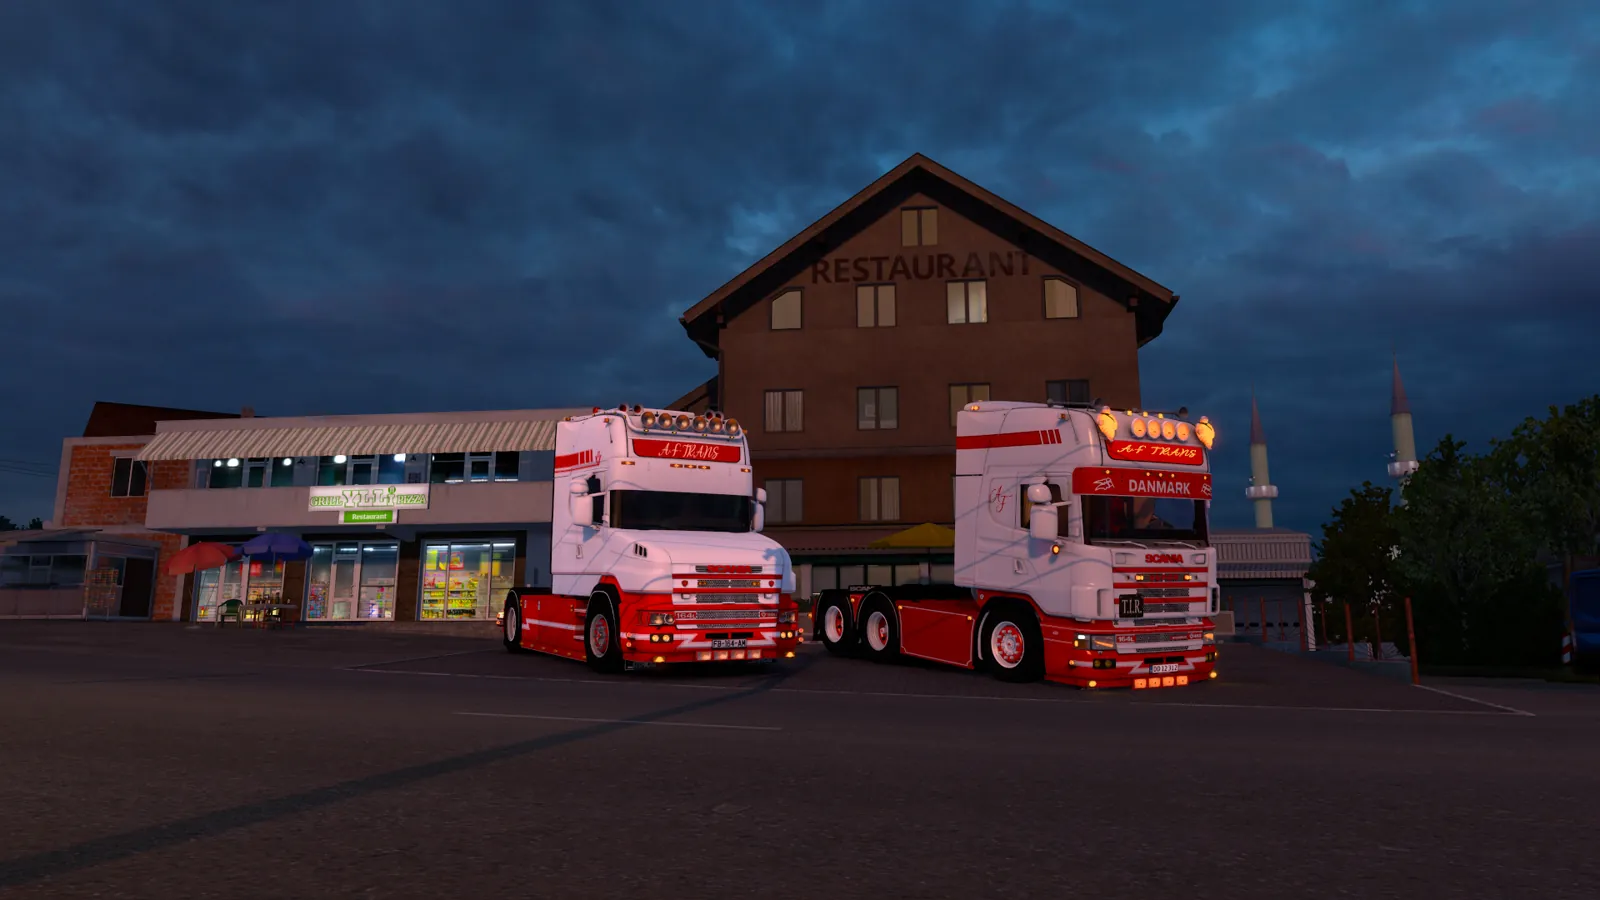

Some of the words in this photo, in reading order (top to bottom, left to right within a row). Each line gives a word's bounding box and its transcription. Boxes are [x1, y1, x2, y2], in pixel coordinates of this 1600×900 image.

[811, 250, 1030, 284] RESTAURANT
[682, 444, 720, 460] TRANS
[1150, 446, 1197, 458] TRANS
[1128, 479, 1191, 495] DANMARK
[310, 495, 343, 507] GRILL
[396, 494, 427, 504] PIZZA
[1145, 553, 1184, 564] SCANIA
